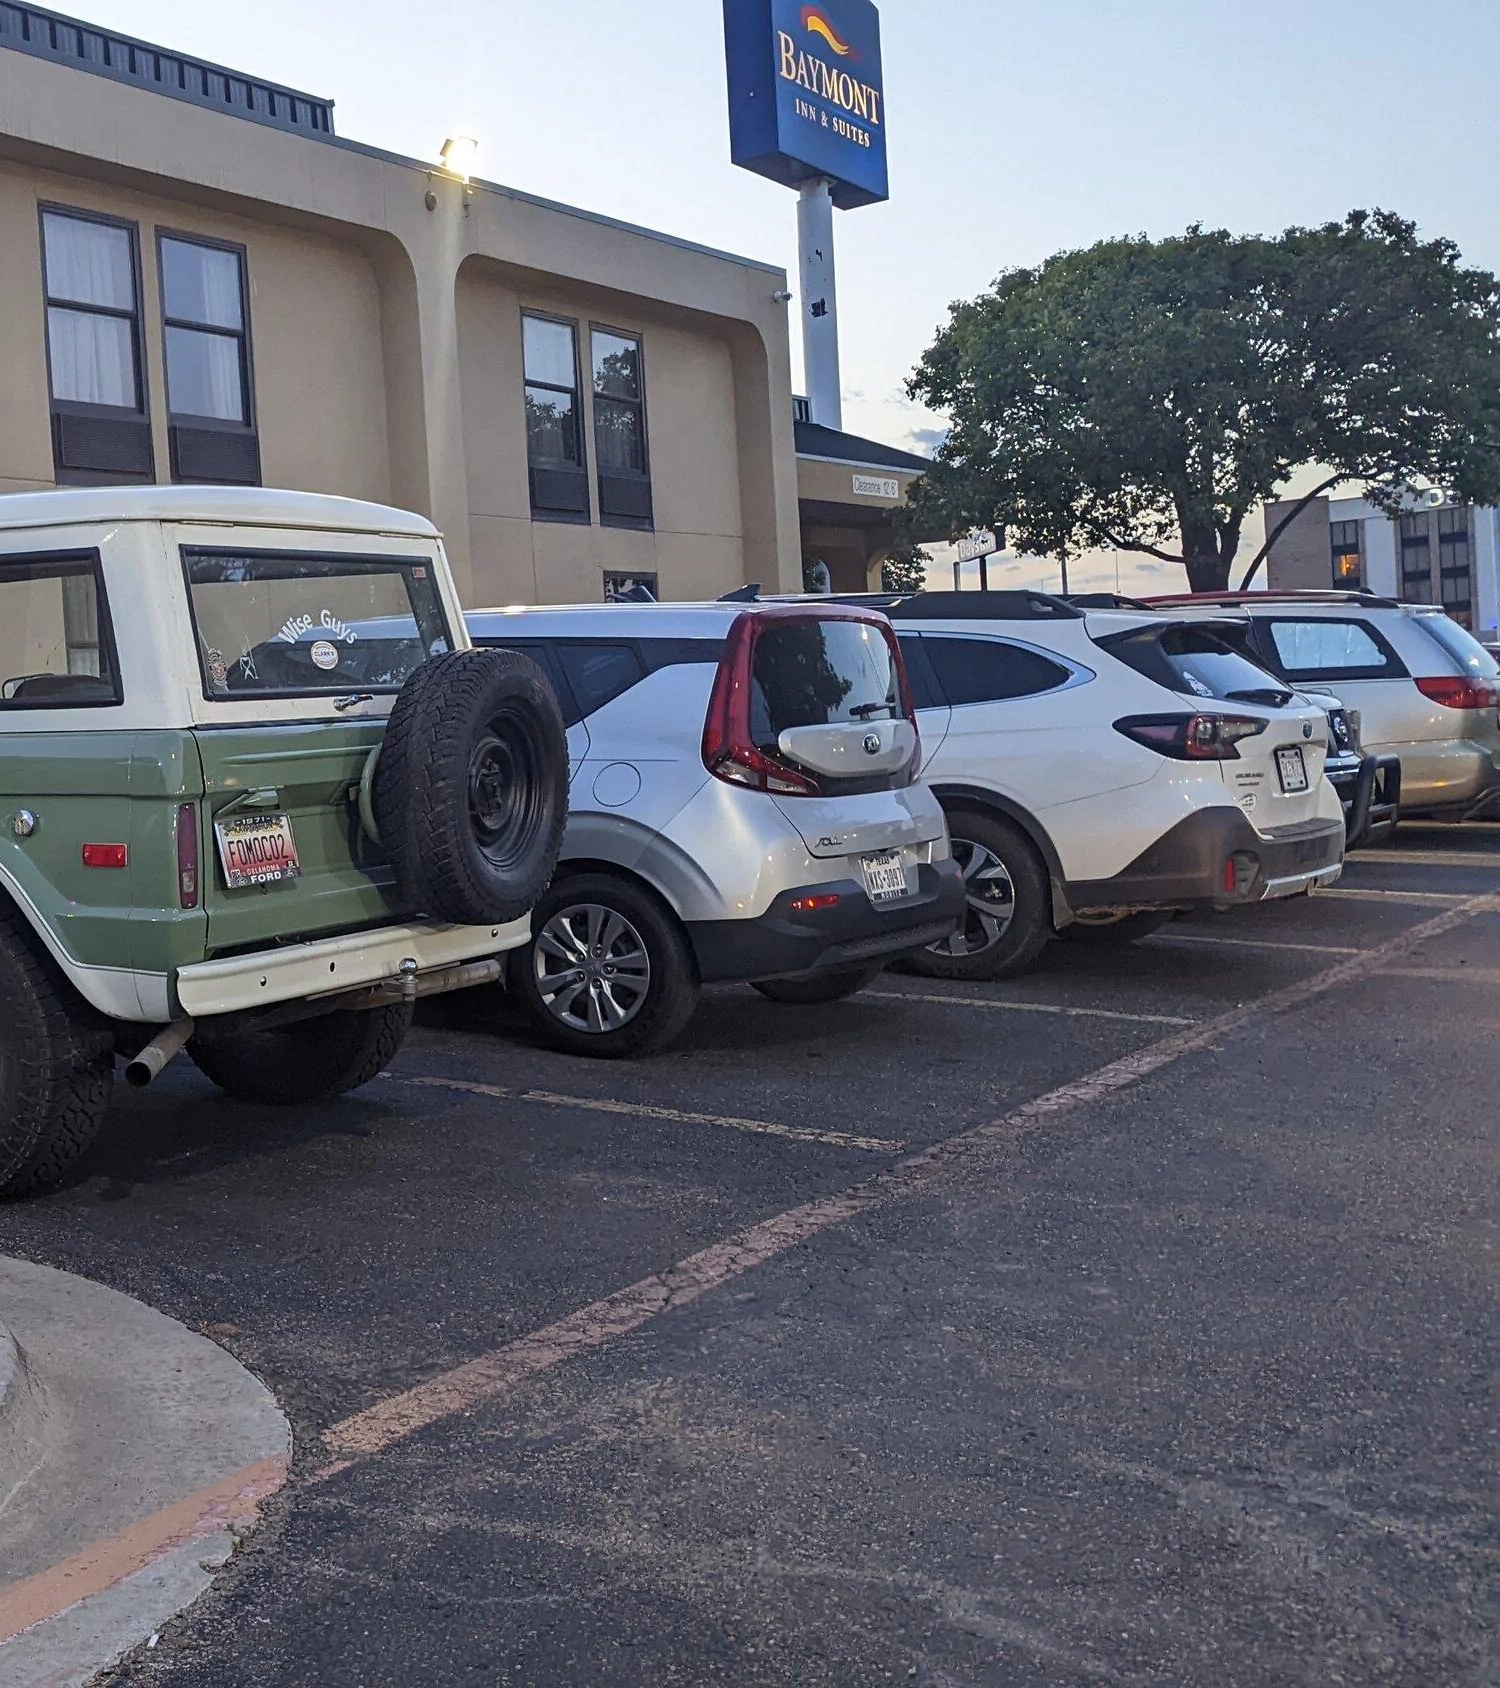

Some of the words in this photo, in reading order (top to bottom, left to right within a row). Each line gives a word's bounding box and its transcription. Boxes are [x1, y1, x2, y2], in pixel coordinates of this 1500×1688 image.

[778, 30, 880, 125] BAYMONT
[795, 98, 816, 122] INN
[821, 110, 828, 128] &
[832, 116, 870, 148] SUITES
[278, 612, 313, 645] Wise
[320, 609, 358, 644] Guys
[246, 864, 281, 876] OKLAHOMA
[876, 855, 890, 866] TEXAS
[251, 871, 282, 884] FORD
